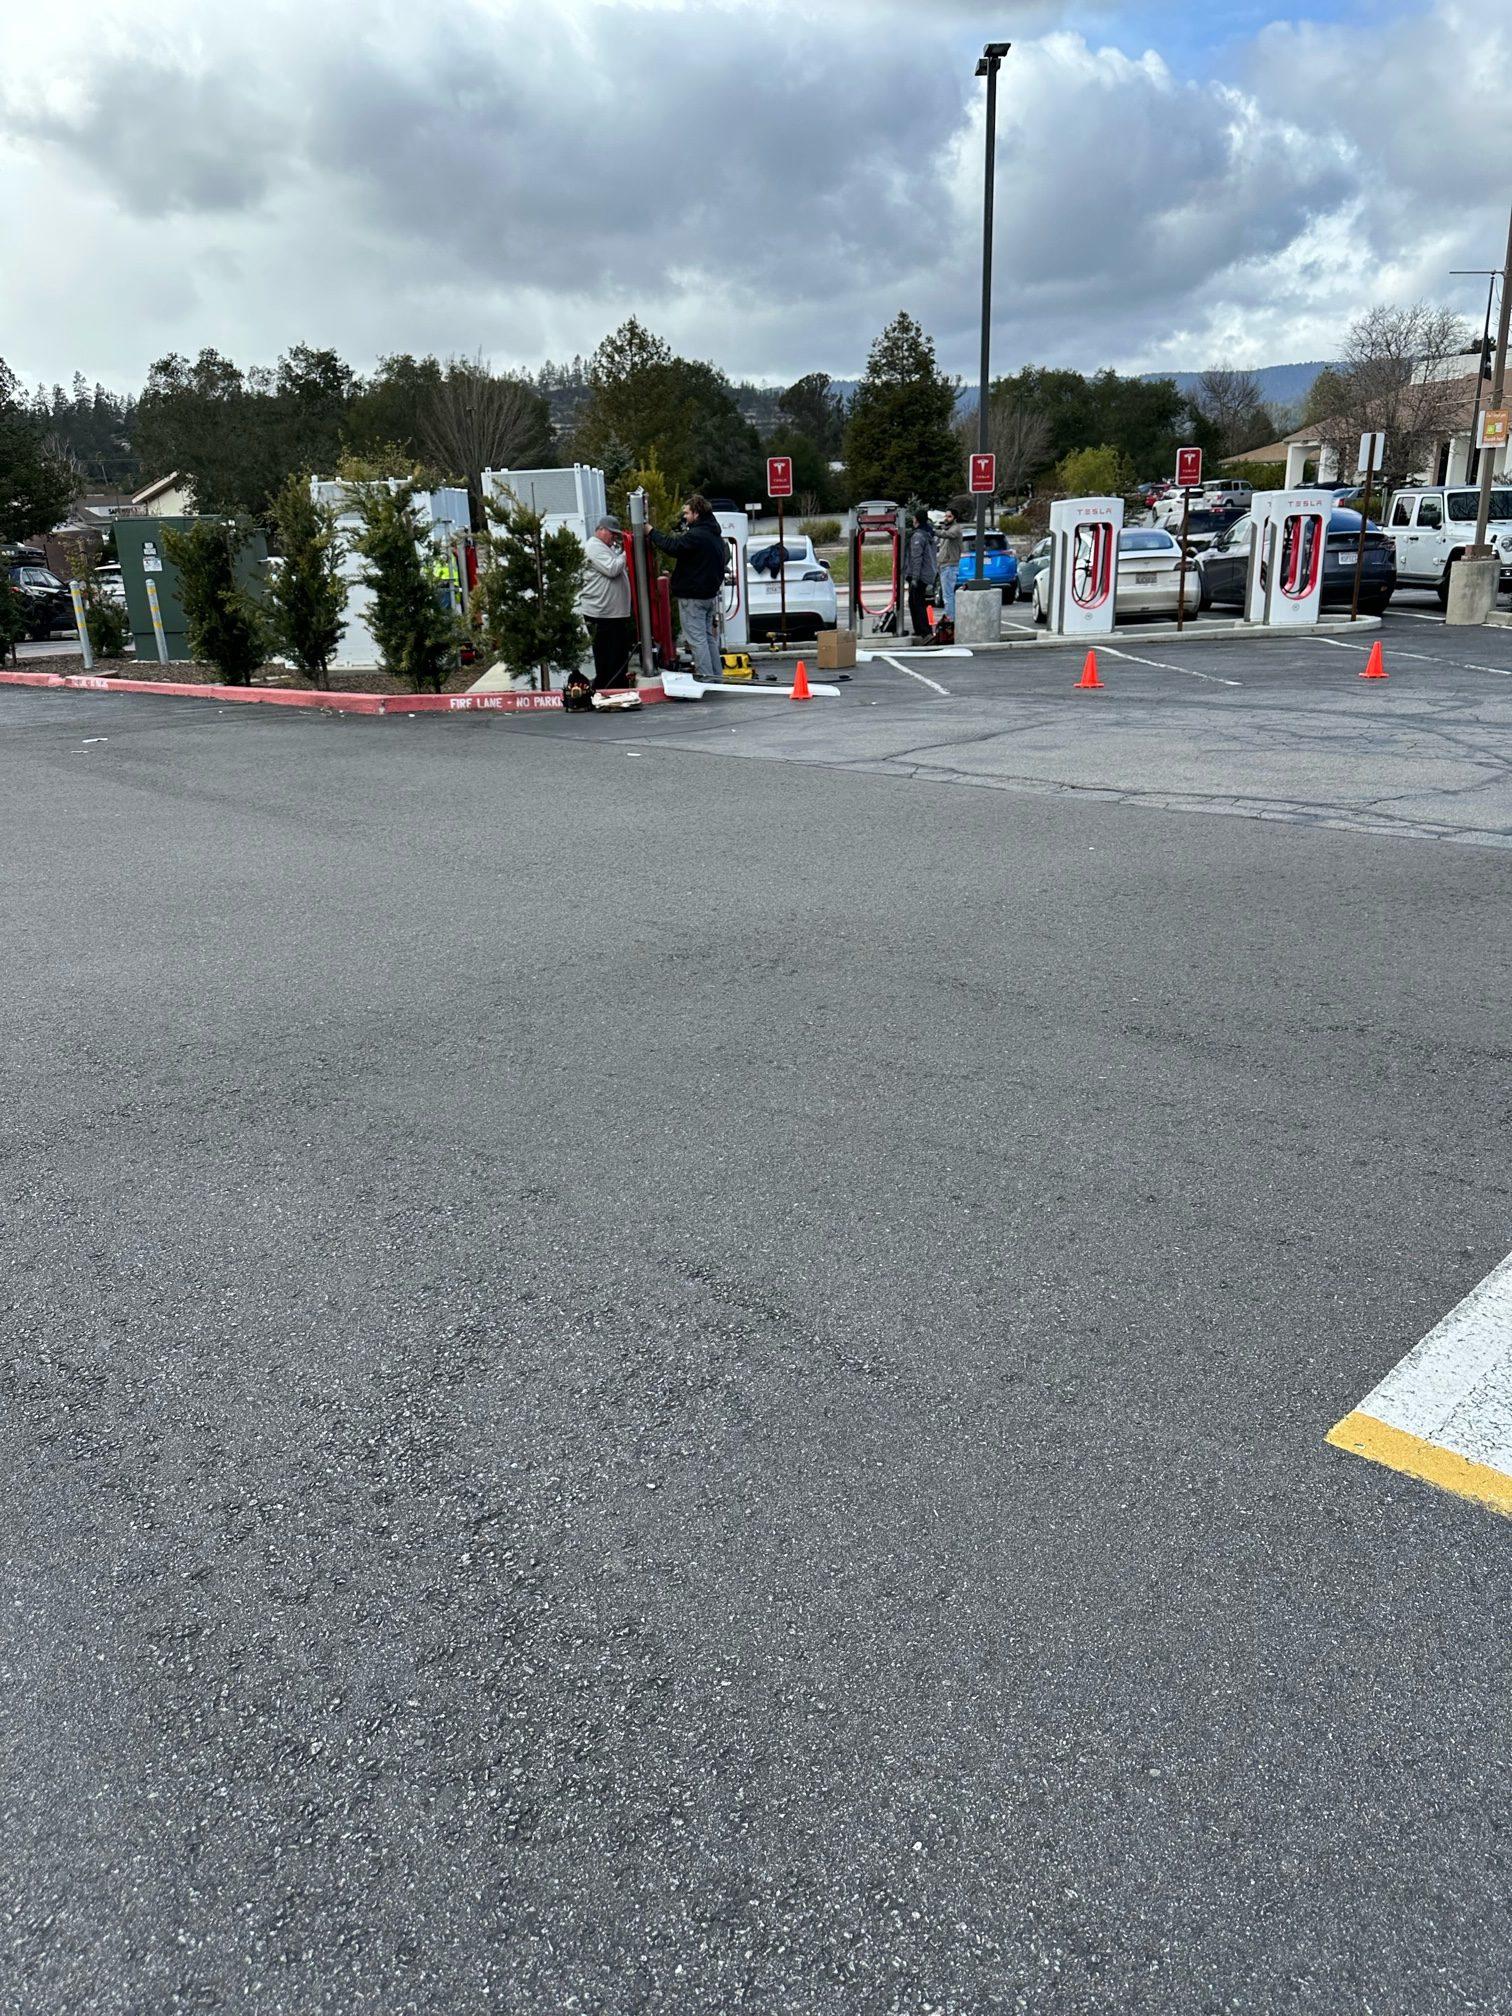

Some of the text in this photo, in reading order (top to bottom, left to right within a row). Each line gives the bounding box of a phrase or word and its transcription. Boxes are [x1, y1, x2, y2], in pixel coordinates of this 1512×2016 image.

[1287, 500, 1322, 508] TESLA
[1076, 507, 1112, 516] TESLA
[449, 697, 473, 709] FIRE
[476, 697, 503, 709] LANE
[516, 696, 530, 707] NO
